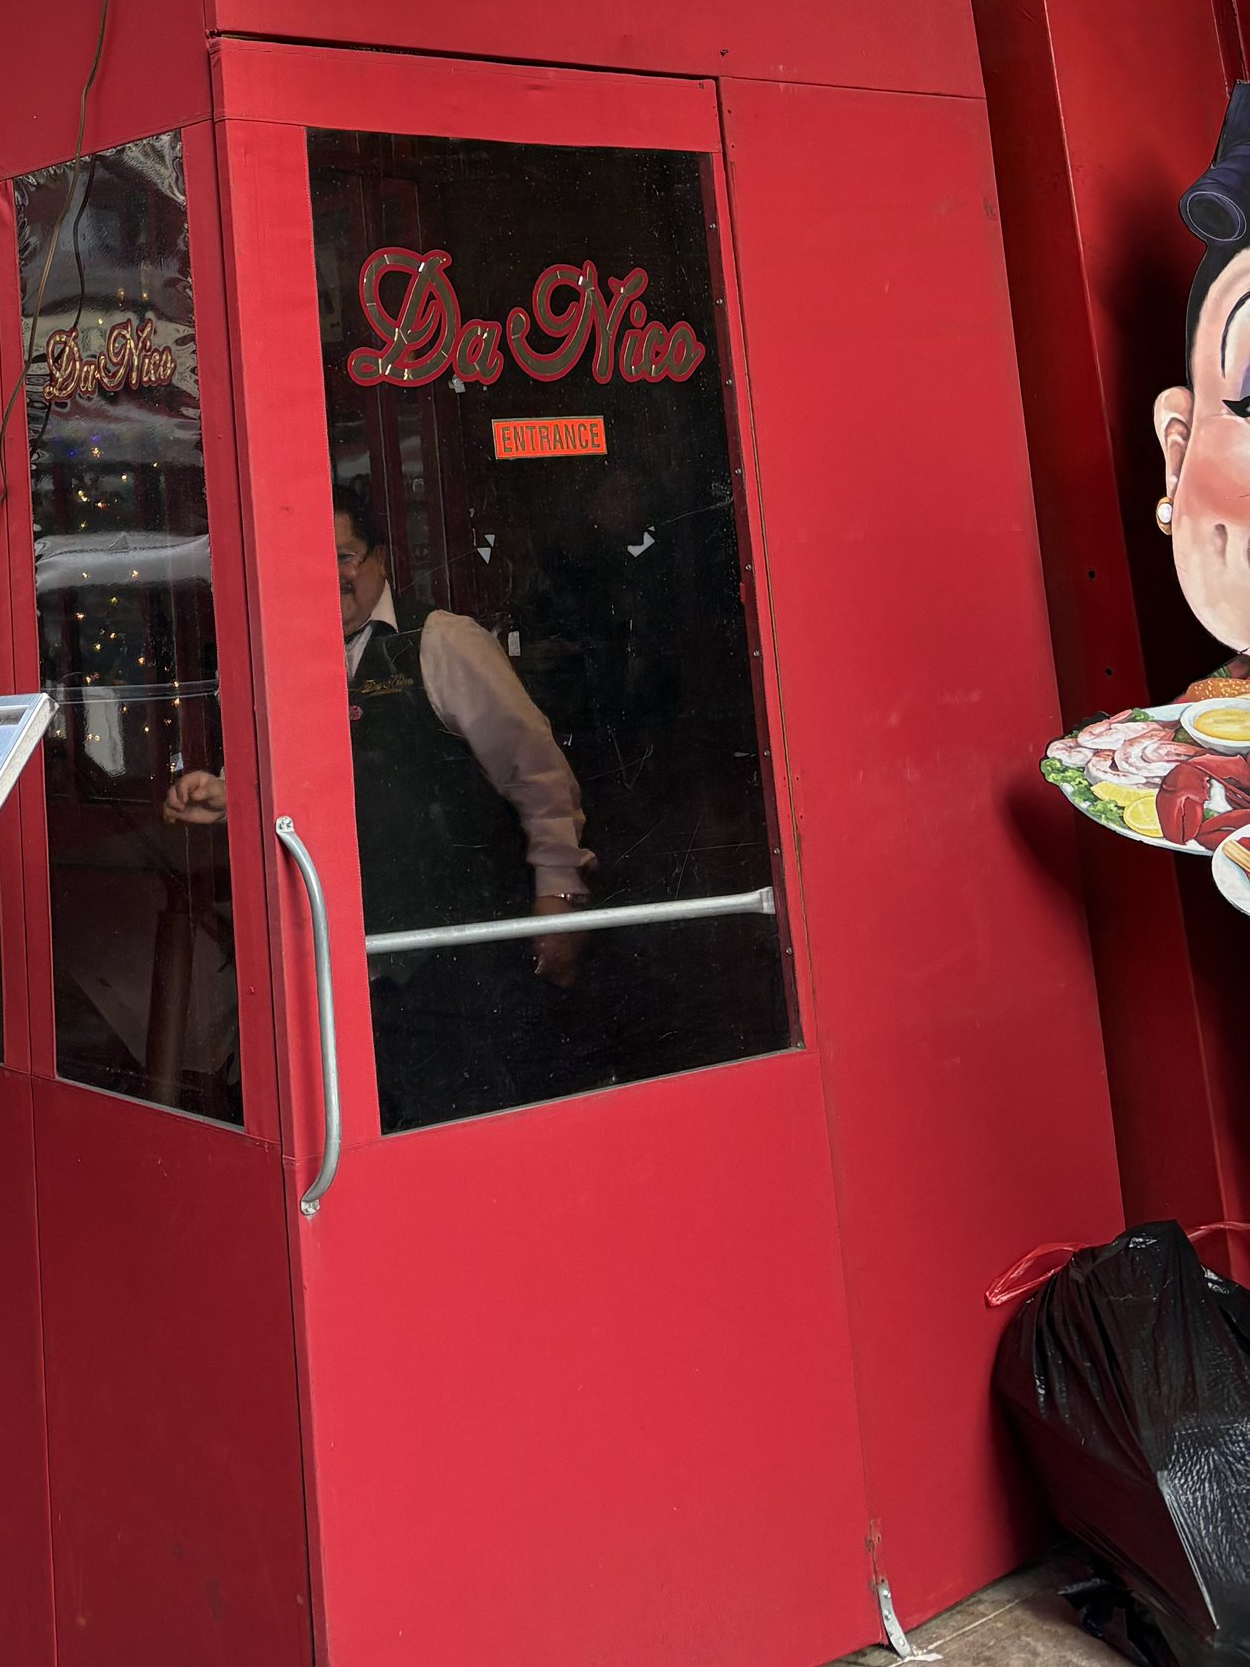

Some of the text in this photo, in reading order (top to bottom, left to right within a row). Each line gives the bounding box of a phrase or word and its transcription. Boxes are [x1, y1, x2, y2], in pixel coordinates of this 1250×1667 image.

[347, 247, 706, 387] Da Nico
[43, 318, 177, 402] Da Nico
[501, 422, 601, 453] ENTRANCE
